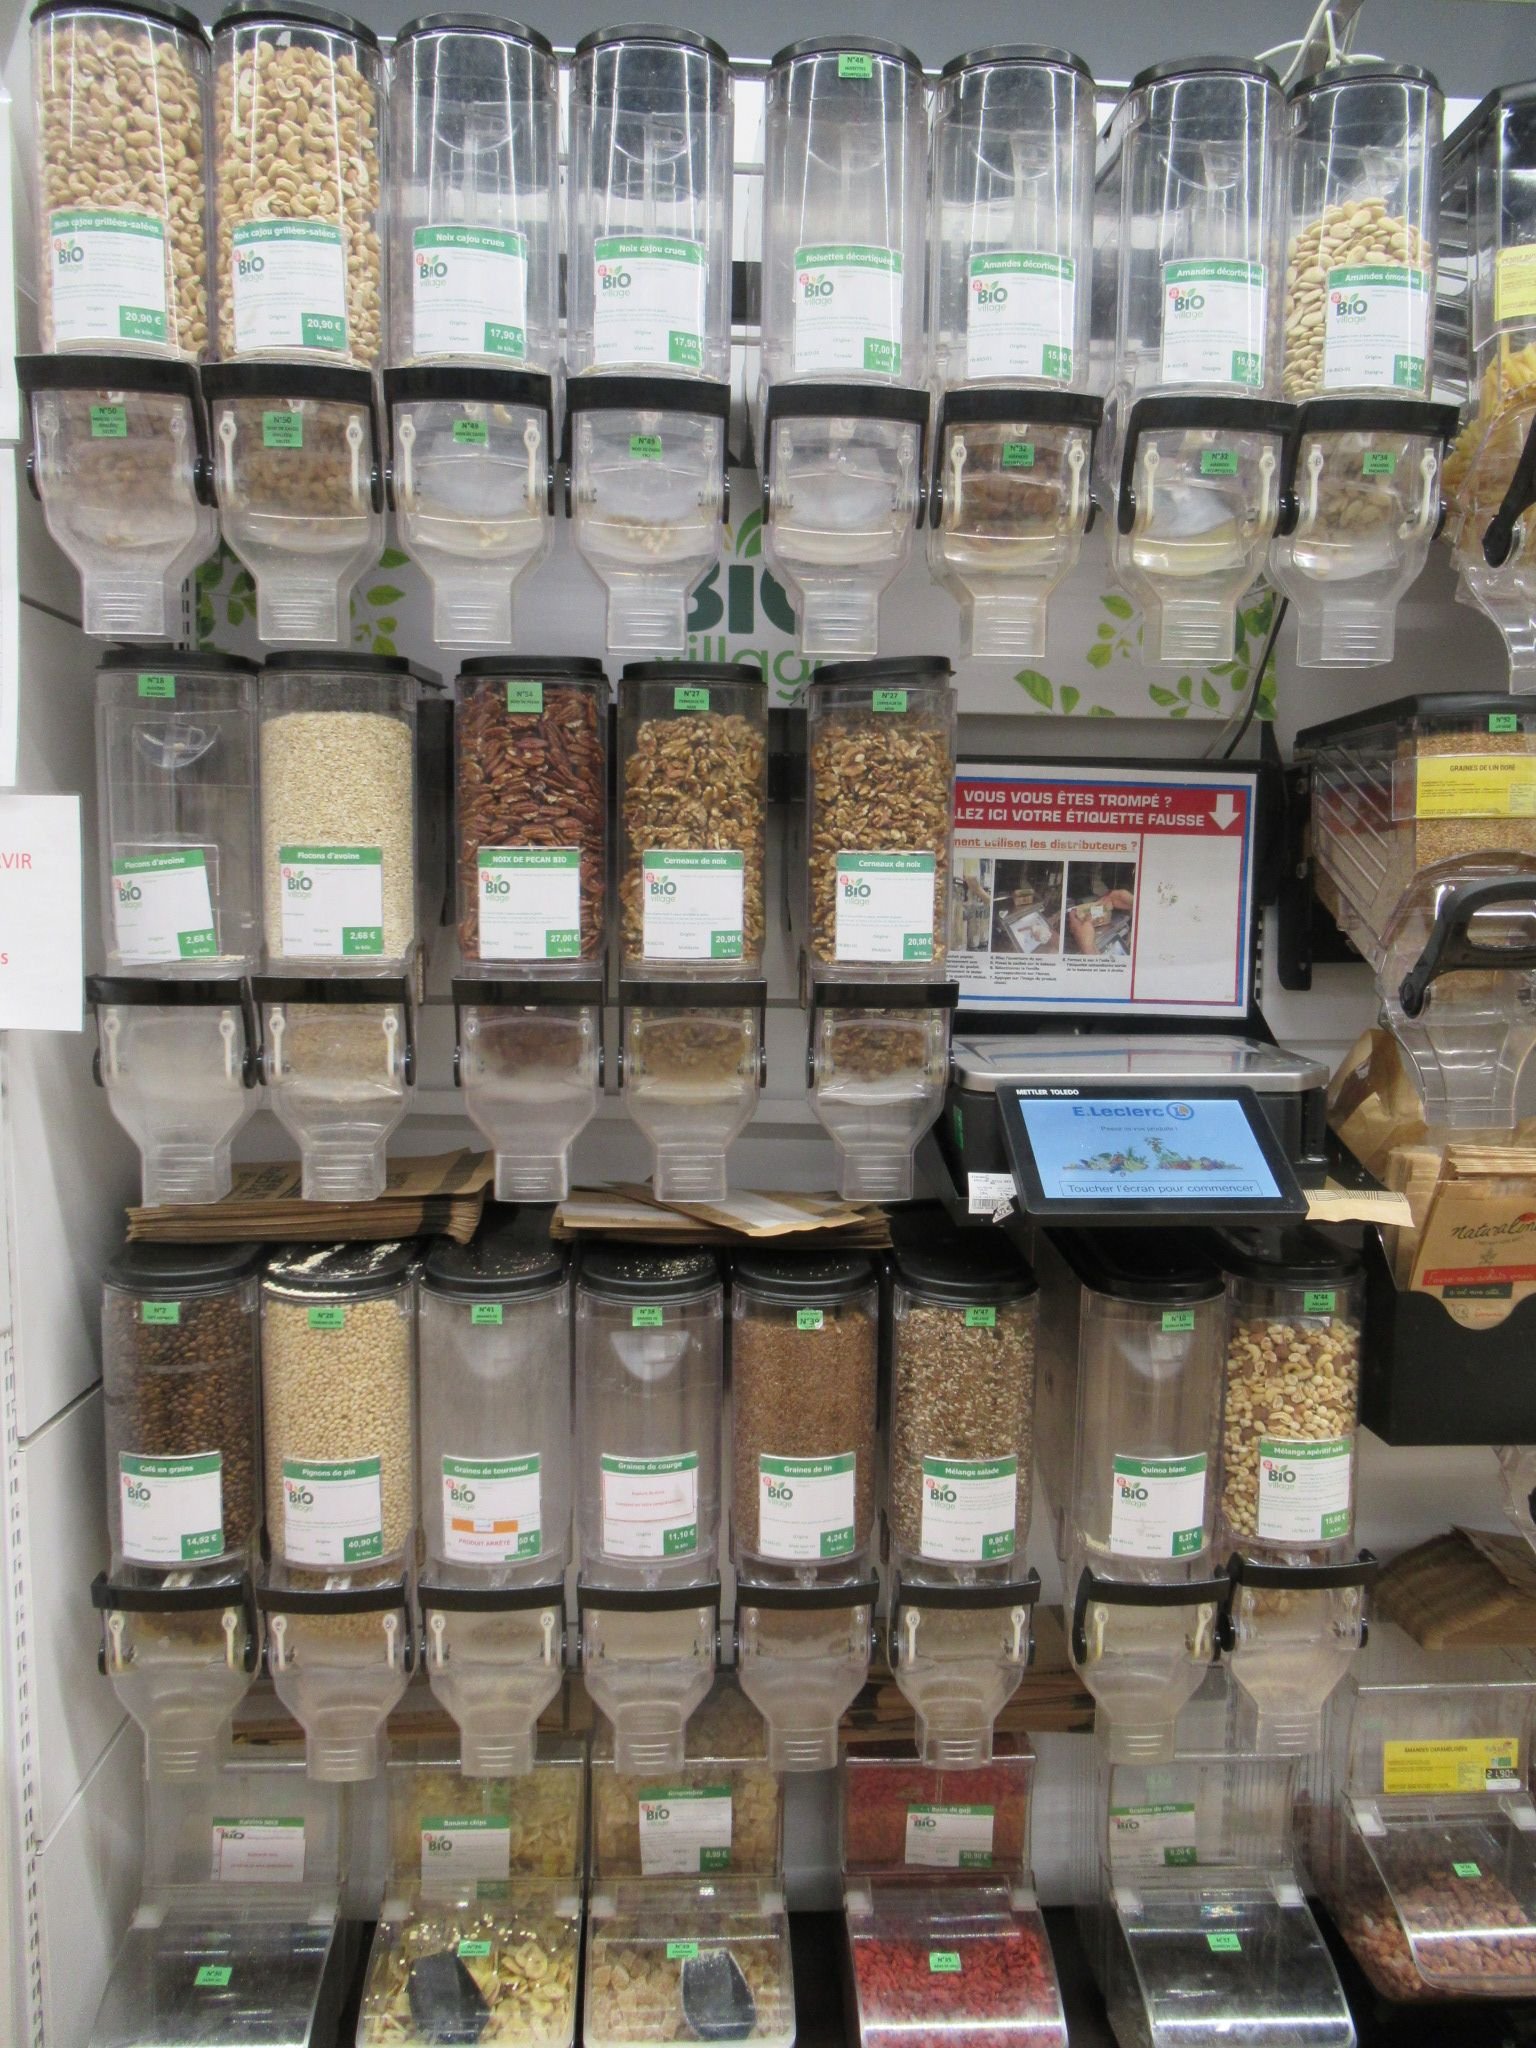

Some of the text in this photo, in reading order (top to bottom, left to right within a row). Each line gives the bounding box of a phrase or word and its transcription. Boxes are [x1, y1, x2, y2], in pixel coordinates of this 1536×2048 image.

[71, 218, 93, 228] cajou
[251, 229, 272, 239] cajou
[436, 233, 505, 248] Noix cajou crues
[619, 245, 687, 256] Noix cajou crues
[806, 252, 843, 263] Noisettes
[984, 260, 1020, 270] Amandes
[1177, 268, 1215, 277] Amandes
[1345, 274, 1383, 282] Amandes
[125, 312, 152, 324] 20,90
[307, 318, 333, 330] 20,90
[490, 328, 515, 341] 17,90
[674, 337, 696, 349] 17,90
[683, 690, 700, 698] N°27
[963, 790, 1172, 808] VOUS VOUS ÊTES TROMPÉ ?
[988, 809, 1007, 821] ICI
[1012, 809, 1061, 823] VOTRE
[1066, 808, 1144, 825] ÉTIQUETTE
[1148, 813, 1205, 827] FAUSSE
[984, 838, 1027, 849] utiliser
[1030, 839, 1047, 849] les
[1050, 838, 1127, 851] distributeurs
[1130, 841, 1137, 850] ?
[0, 853, 32, 869] VIR
[663, 857, 699, 865] Cerneaux
[700, 857, 711, 865] de
[858, 860, 893, 868] Cerneaux
[550, 934, 572, 942] 27,00
[715, 935, 736, 944] 20,90
[1072, 1106, 1164, 1117] E.Leclerc
[1068, 1184, 1253, 1195] Toucher l'écran pour commencer
[1274, 1447, 1306, 1456] Mélange
[454, 1465, 480, 1475] Graines
[618, 1462, 645, 1470] Graines
[1141, 1466, 1167, 1474] Quinoa
[302, 1469, 330, 1477] Pignons
[344, 1469, 356, 1477] pin
[945, 1467, 999, 1477] Mélange salade
[459, 1538, 484, 1546] PRODUIT
